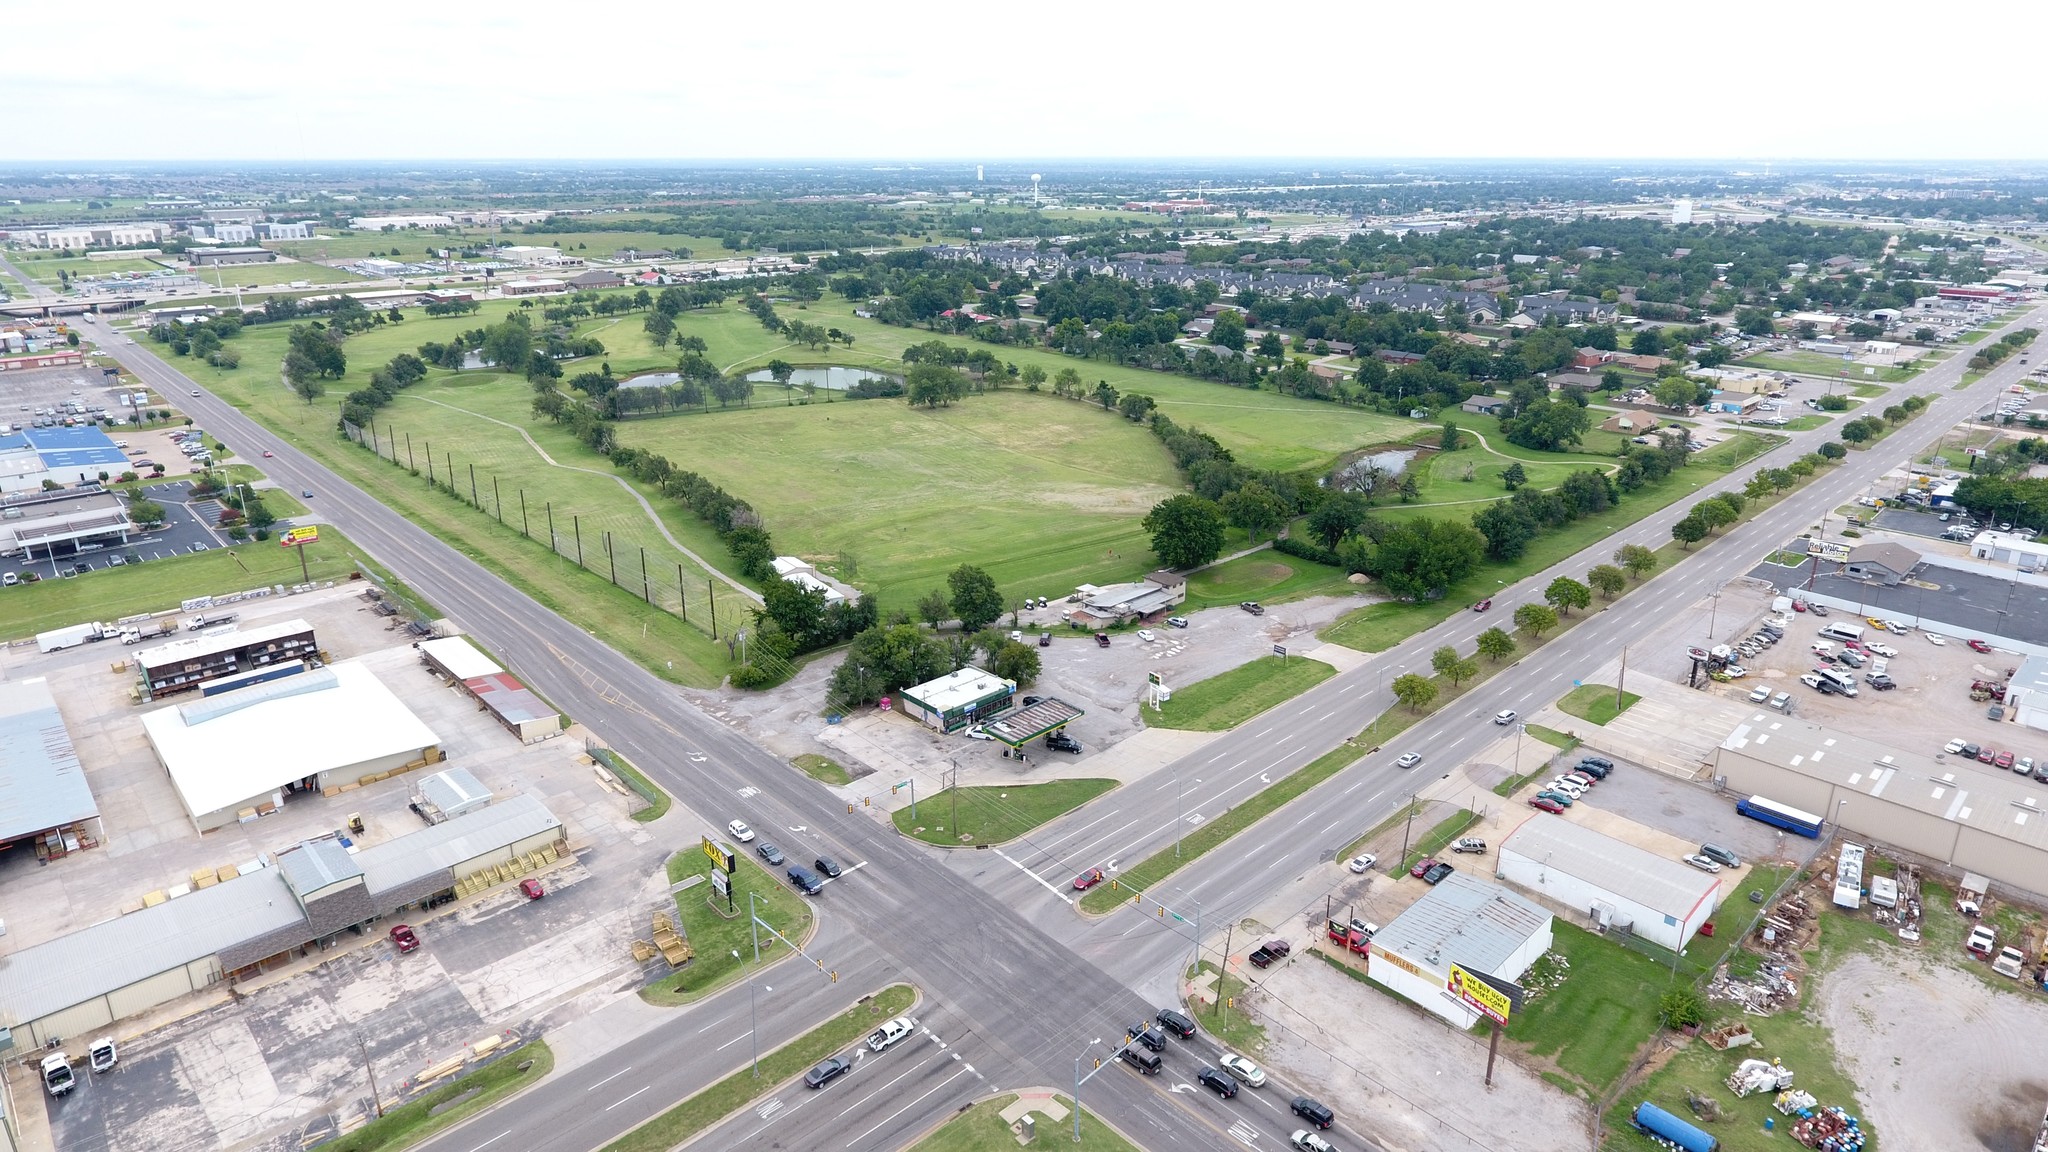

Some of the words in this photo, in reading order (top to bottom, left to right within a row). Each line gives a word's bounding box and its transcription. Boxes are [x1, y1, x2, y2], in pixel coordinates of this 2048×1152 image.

[1810, 541, 1840, 553] Reliable
[704, 839, 721, 861] FOX
[1384, 951, 1414, 973] MUFFLERS
[1466, 976, 1476, 985] WE
[1478, 982, 1490, 993] BUY
[1491, 992, 1507, 1004] UGLY
[1467, 983, 1505, 1010] HOUSES.COM
